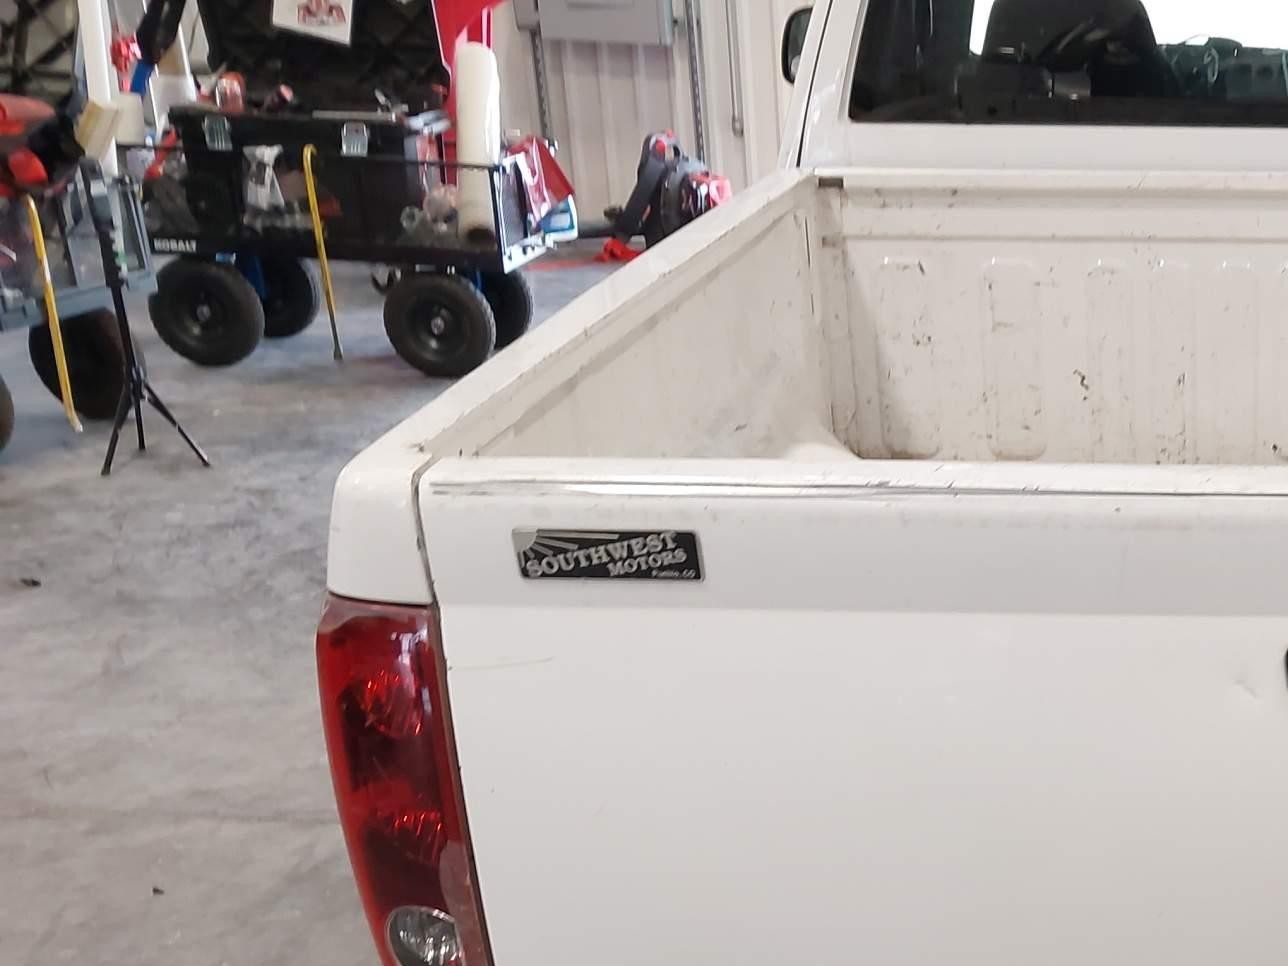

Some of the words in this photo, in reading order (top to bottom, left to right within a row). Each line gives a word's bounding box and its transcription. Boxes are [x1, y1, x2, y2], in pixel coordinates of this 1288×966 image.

[153, 238, 197, 253] KOBALT
[526, 530, 678, 578] SOUTHWEST
[606, 548, 688, 577] MOTORS
